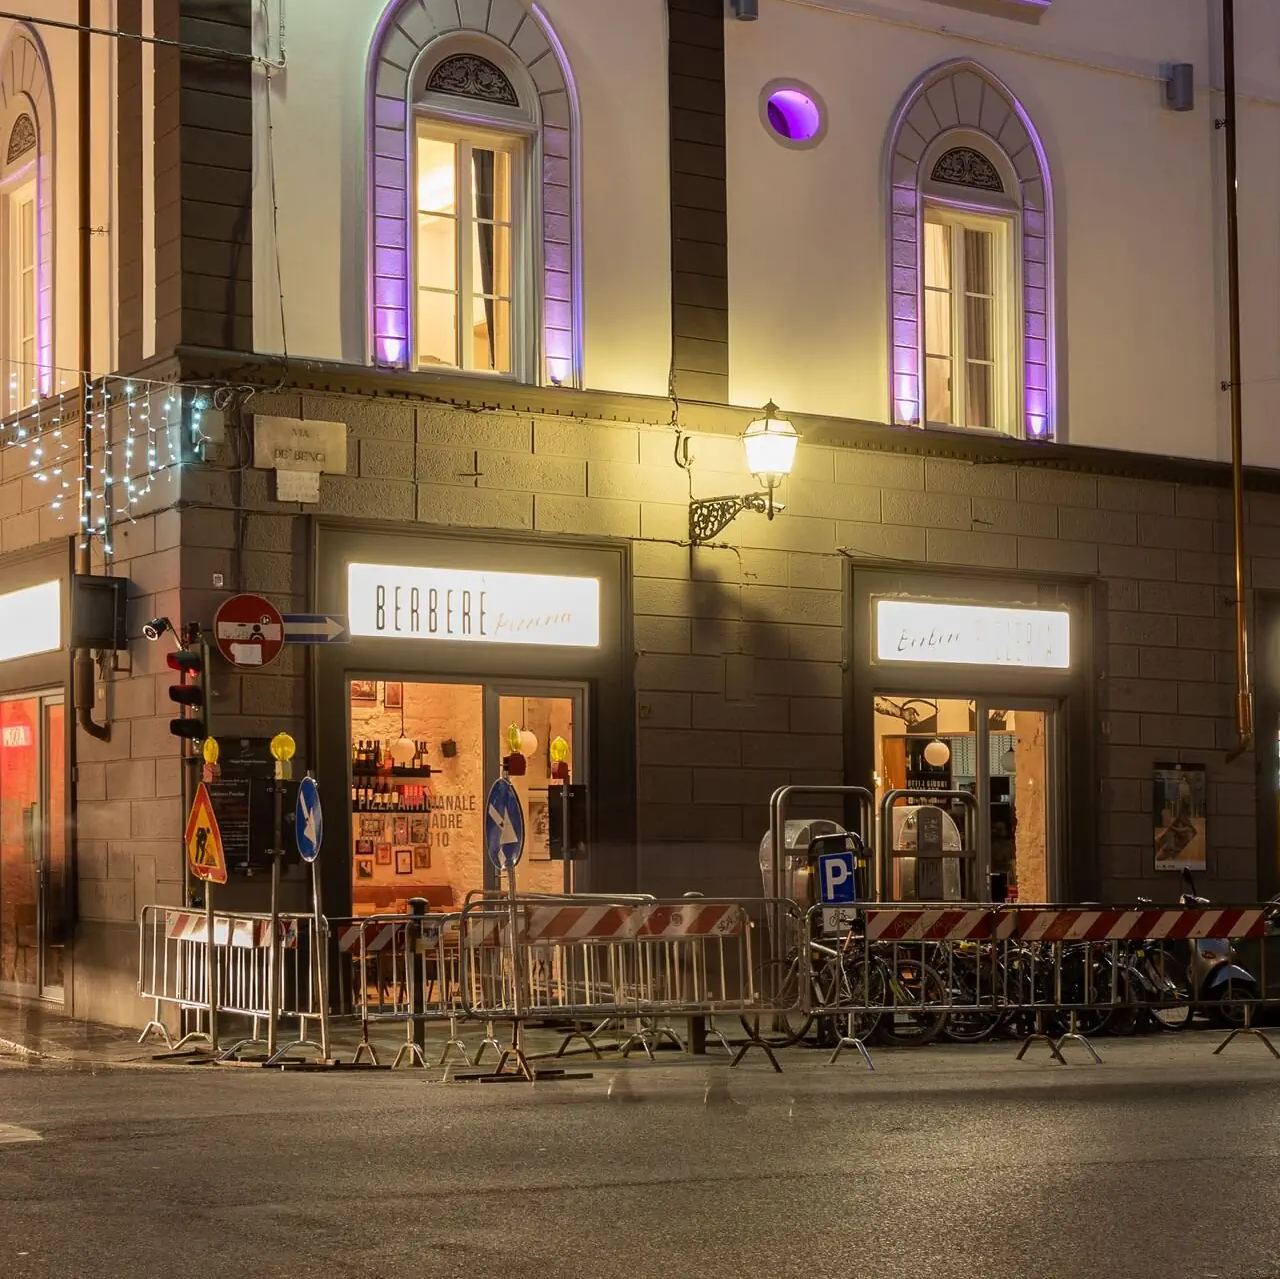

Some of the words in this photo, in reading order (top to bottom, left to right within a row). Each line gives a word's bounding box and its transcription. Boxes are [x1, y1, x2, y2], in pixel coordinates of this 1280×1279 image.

[292, 427, 309, 438] VIA
[294, 450, 326, 463] BENCI
[825, 858, 848, 900] P
